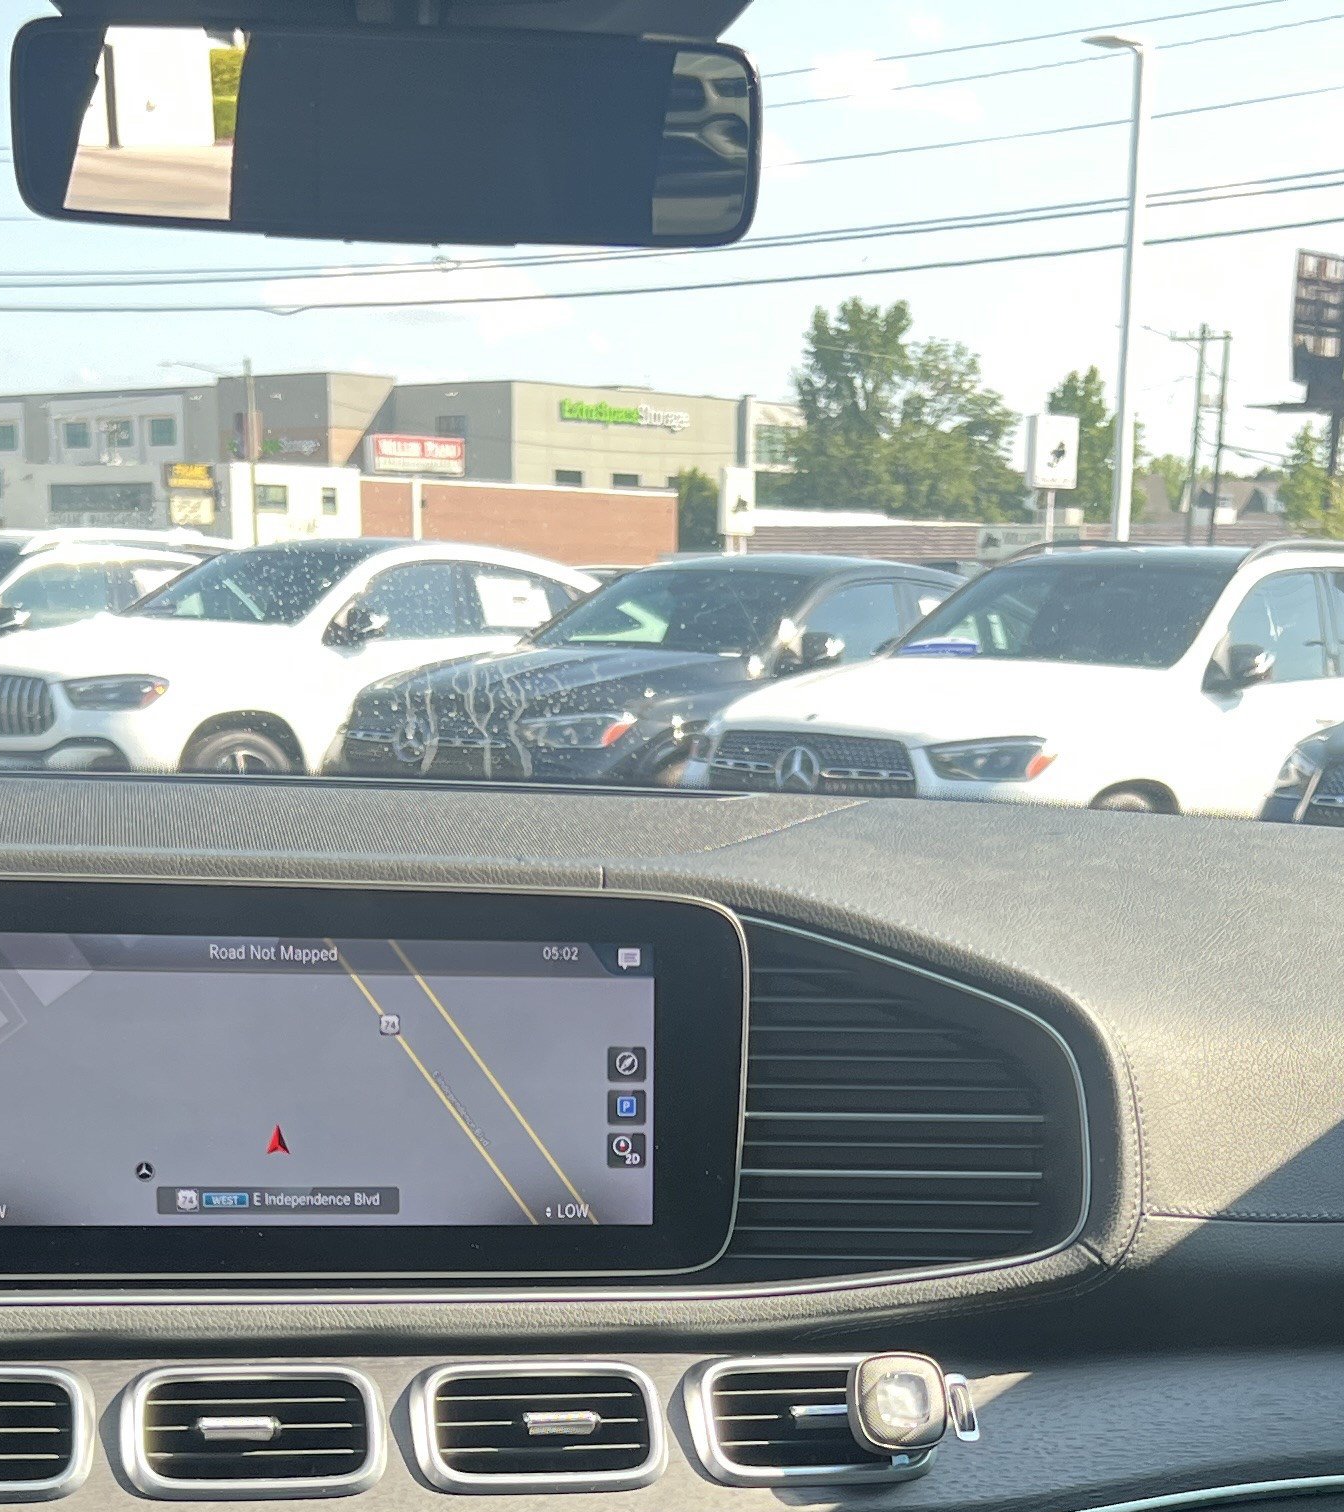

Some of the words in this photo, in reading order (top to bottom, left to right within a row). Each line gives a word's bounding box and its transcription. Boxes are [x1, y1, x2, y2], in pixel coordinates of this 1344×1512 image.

[209, 945, 246, 961] Road
[250, 945, 276, 961] Not
[280, 946, 338, 964] Mapped
[542, 946, 580, 962] 05:02
[384, 1019, 397, 1031] 74
[625, 1152, 641, 1165] 2D
[211, 1194, 239, 1206] WEST
[253, 1192, 262, 1206] E
[264, 1192, 351, 1208] Independence
[354, 1192, 380, 1206] Blvd
[557, 1203, 590, 1219] LOW
